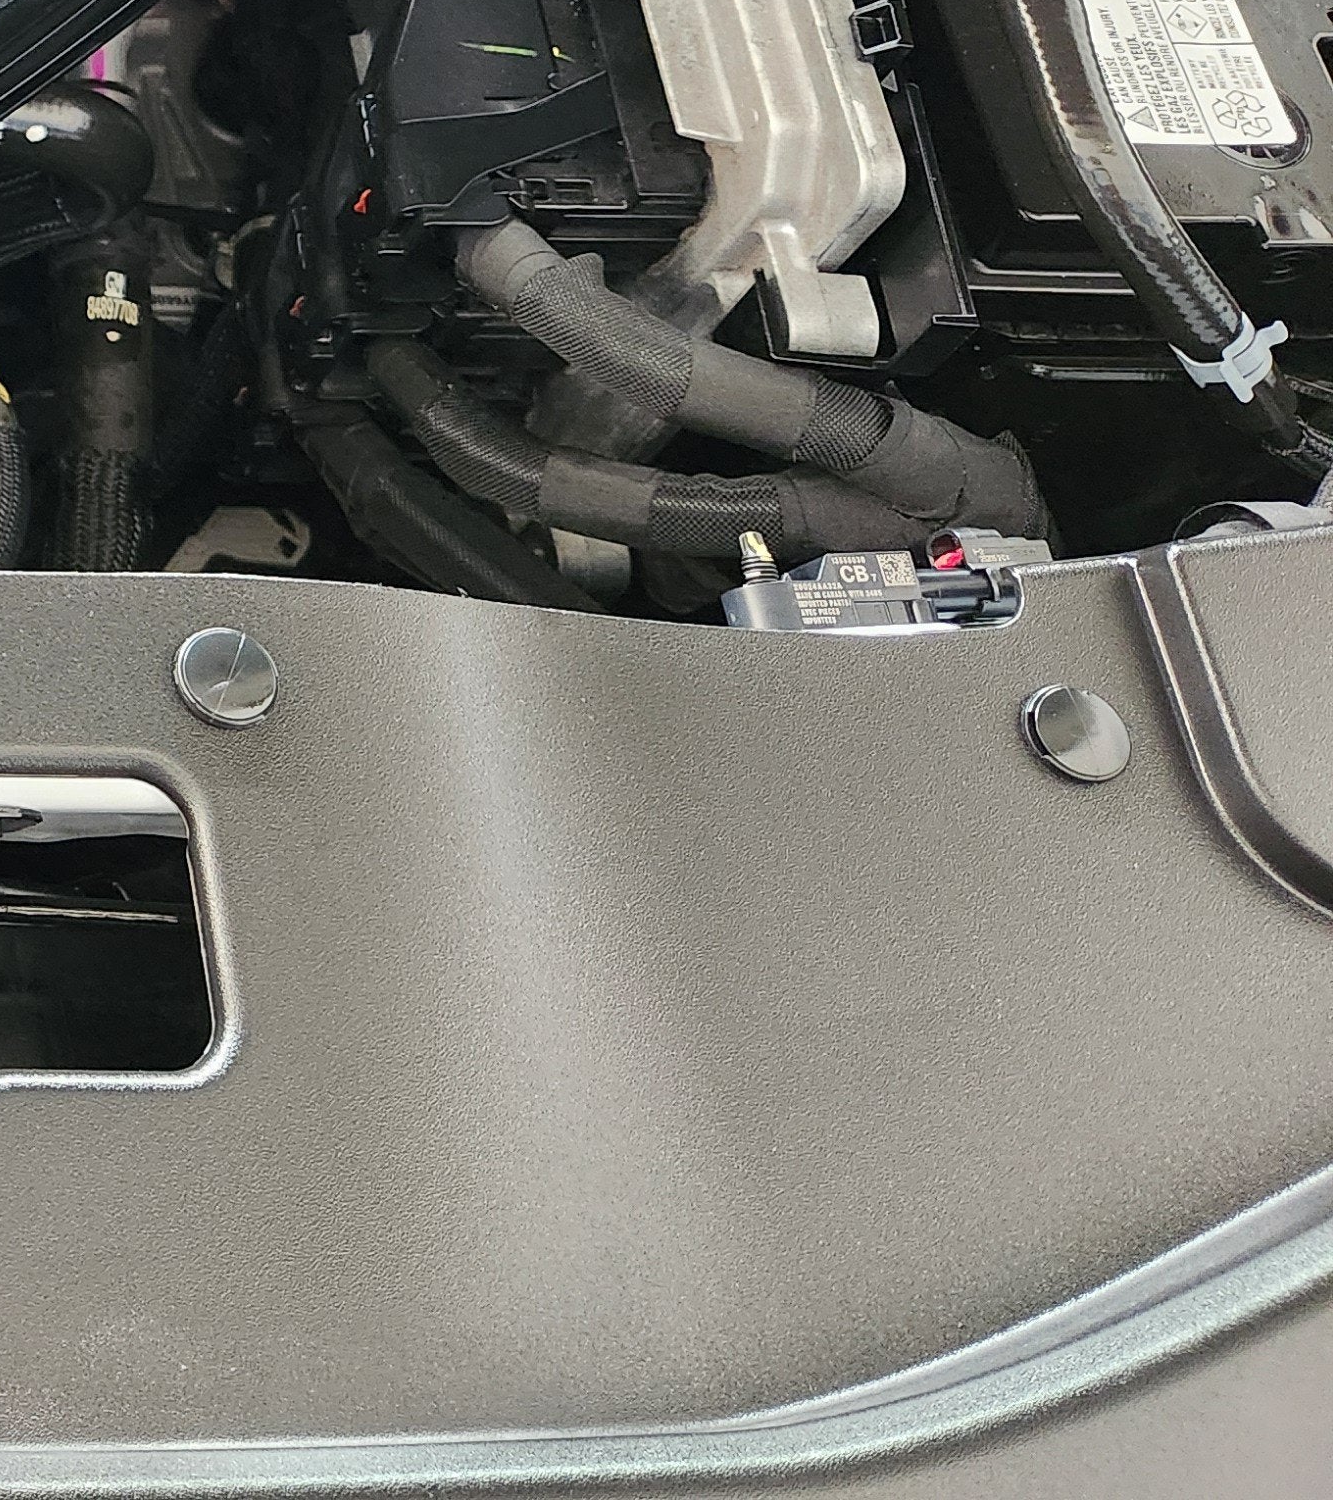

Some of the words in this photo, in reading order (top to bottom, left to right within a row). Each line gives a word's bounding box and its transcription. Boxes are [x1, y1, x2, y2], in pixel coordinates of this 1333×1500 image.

[1098, 6, 1119, 38] INJURY.
[1127, 0, 1150, 38] PEUVENT
[1113, 41, 1125, 53] OR
[1125, 33, 1145, 60] YEUX.
[1160, 43, 1180, 77] RENDRE
[1105, 56, 1125, 83] CAUSE
[1139, 64, 1154, 81] LES
[1143, 40, 1173, 91] EXPLOSIFS
[1119, 56, 1147, 103] BLINDNESS
[1174, 80, 1186, 91] OU
[1118, 87, 1133, 103] CAN
[1167, 95, 1183, 113] GAZ
[1174, 113, 1191, 133] LES
[1179, 94, 1205, 133] BLESSER
[839, 565, 869, 583] CB
